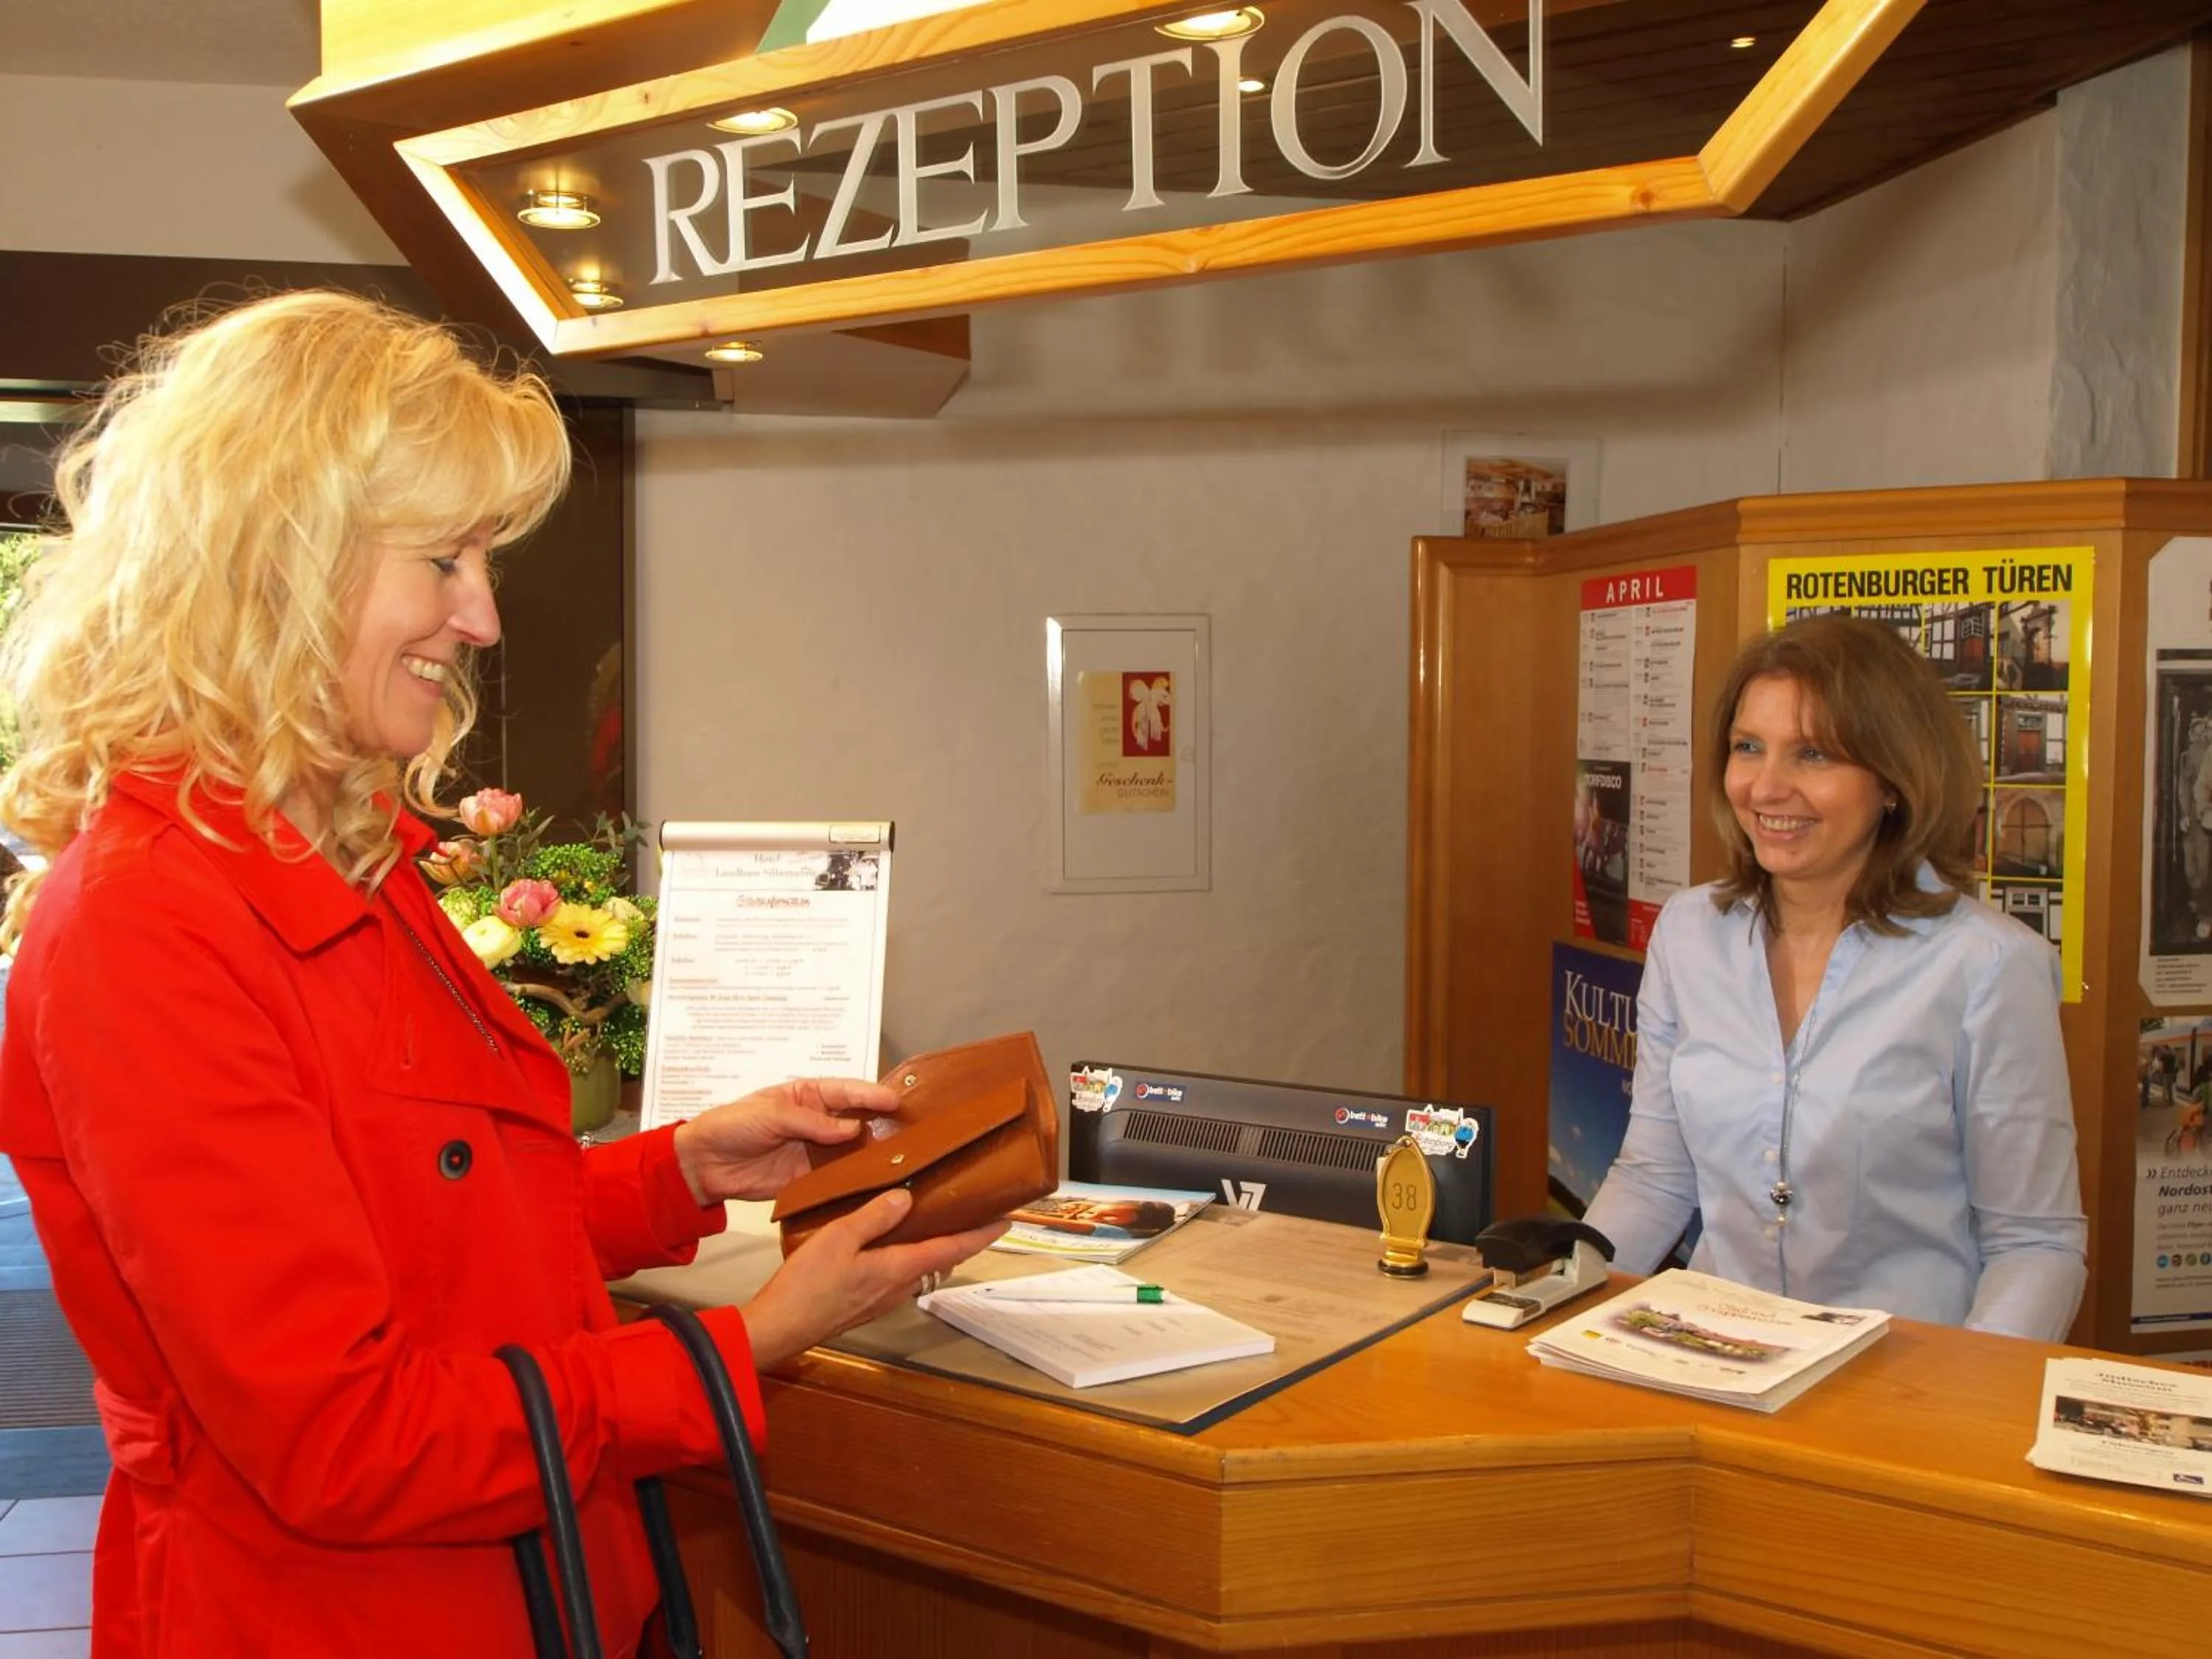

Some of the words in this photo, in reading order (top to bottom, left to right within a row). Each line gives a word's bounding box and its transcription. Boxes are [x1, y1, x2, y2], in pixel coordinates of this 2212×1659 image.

[642, 0, 1543, 285] REZEPTION
[1606, 576, 1664, 603] APRIL
[1786, 568, 1969, 599] ROTENBURGER
[1983, 558, 2073, 594] TÜREN
[1221, 1179, 1267, 1211] V7
[1391, 1182, 1416, 1211] 38
[2157, 1203, 2188, 1218] ganz
